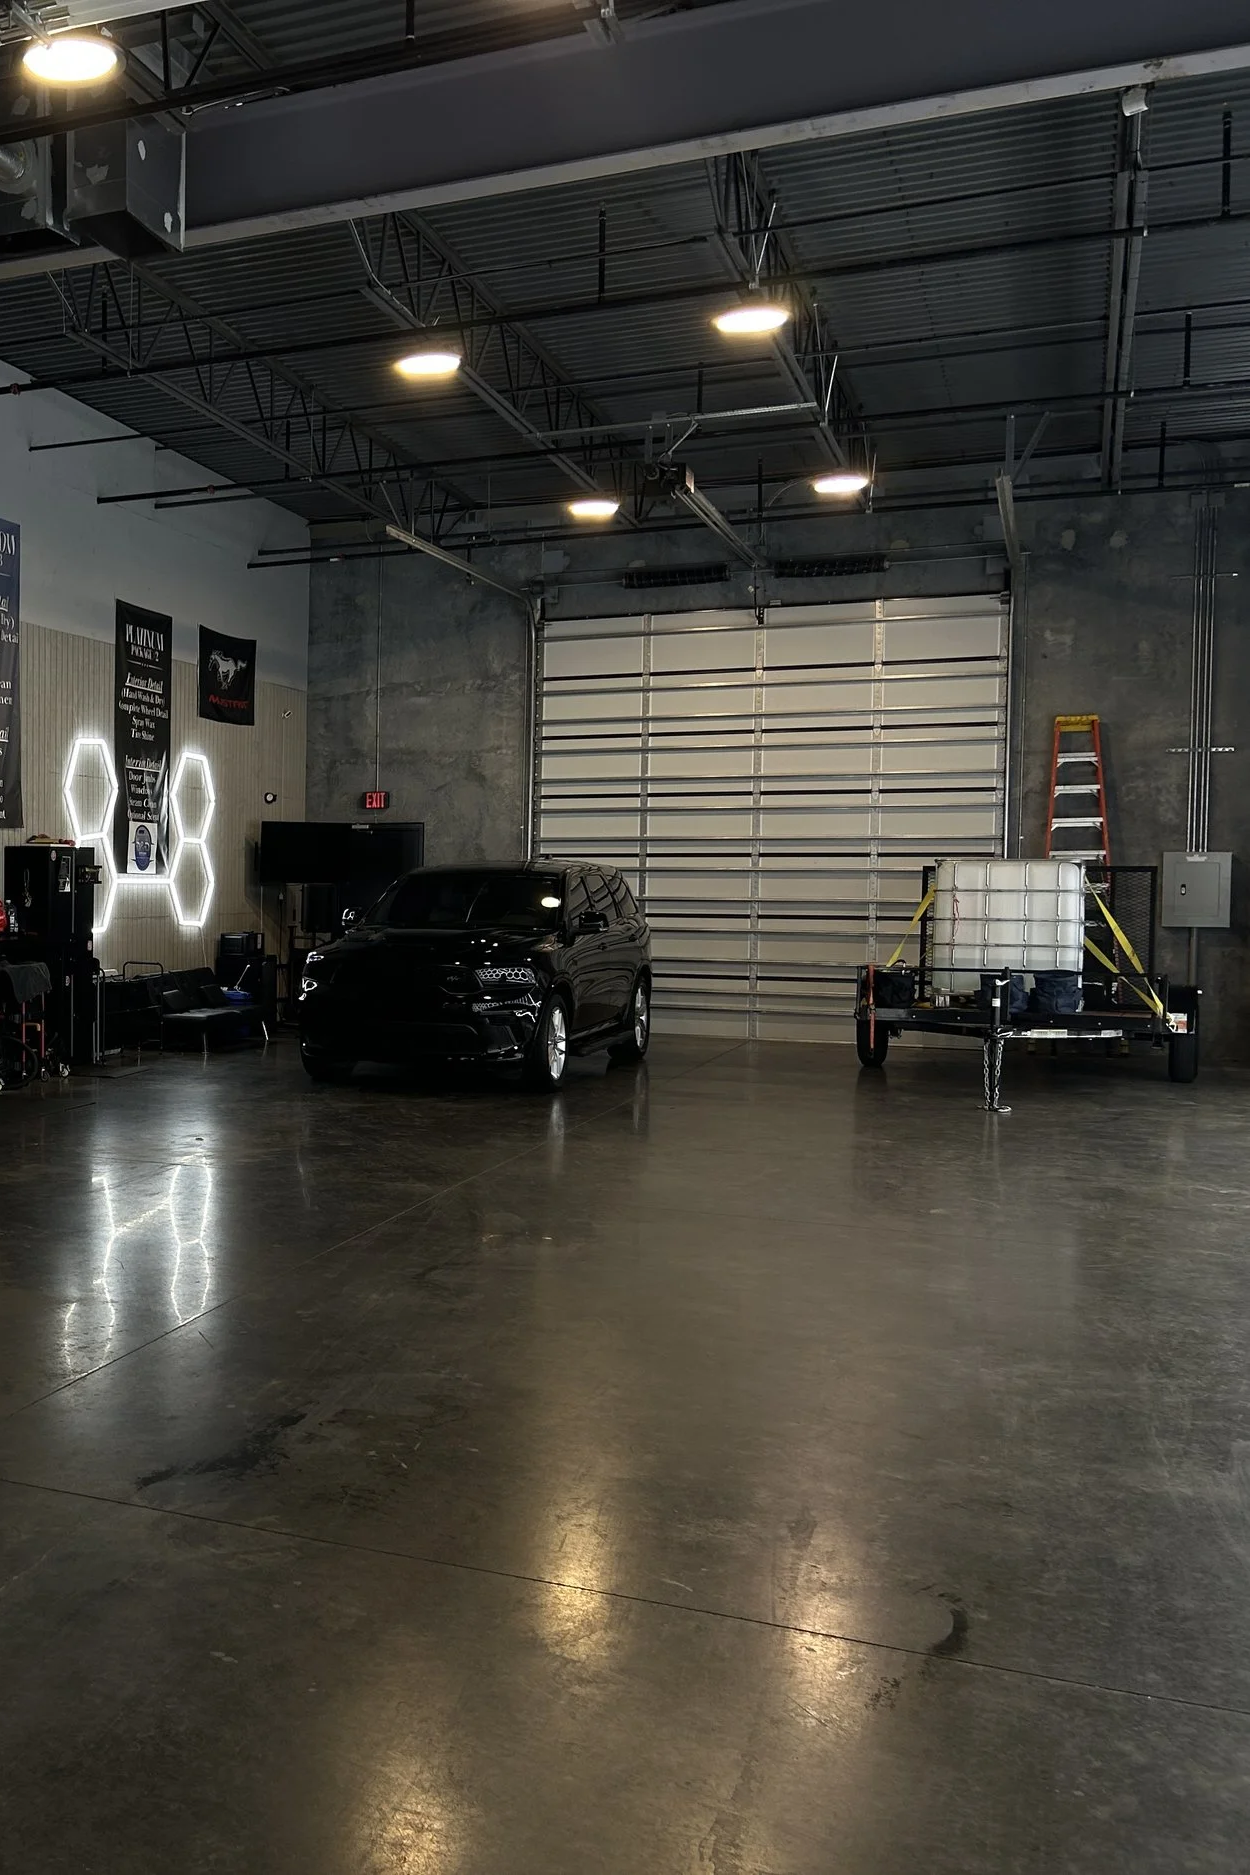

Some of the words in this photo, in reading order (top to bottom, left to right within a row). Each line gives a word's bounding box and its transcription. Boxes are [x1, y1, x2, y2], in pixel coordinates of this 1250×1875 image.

[125, 623, 164, 652] PLATINUM
[128, 770, 143, 781] Door
[366, 792, 386, 809] EXIT
